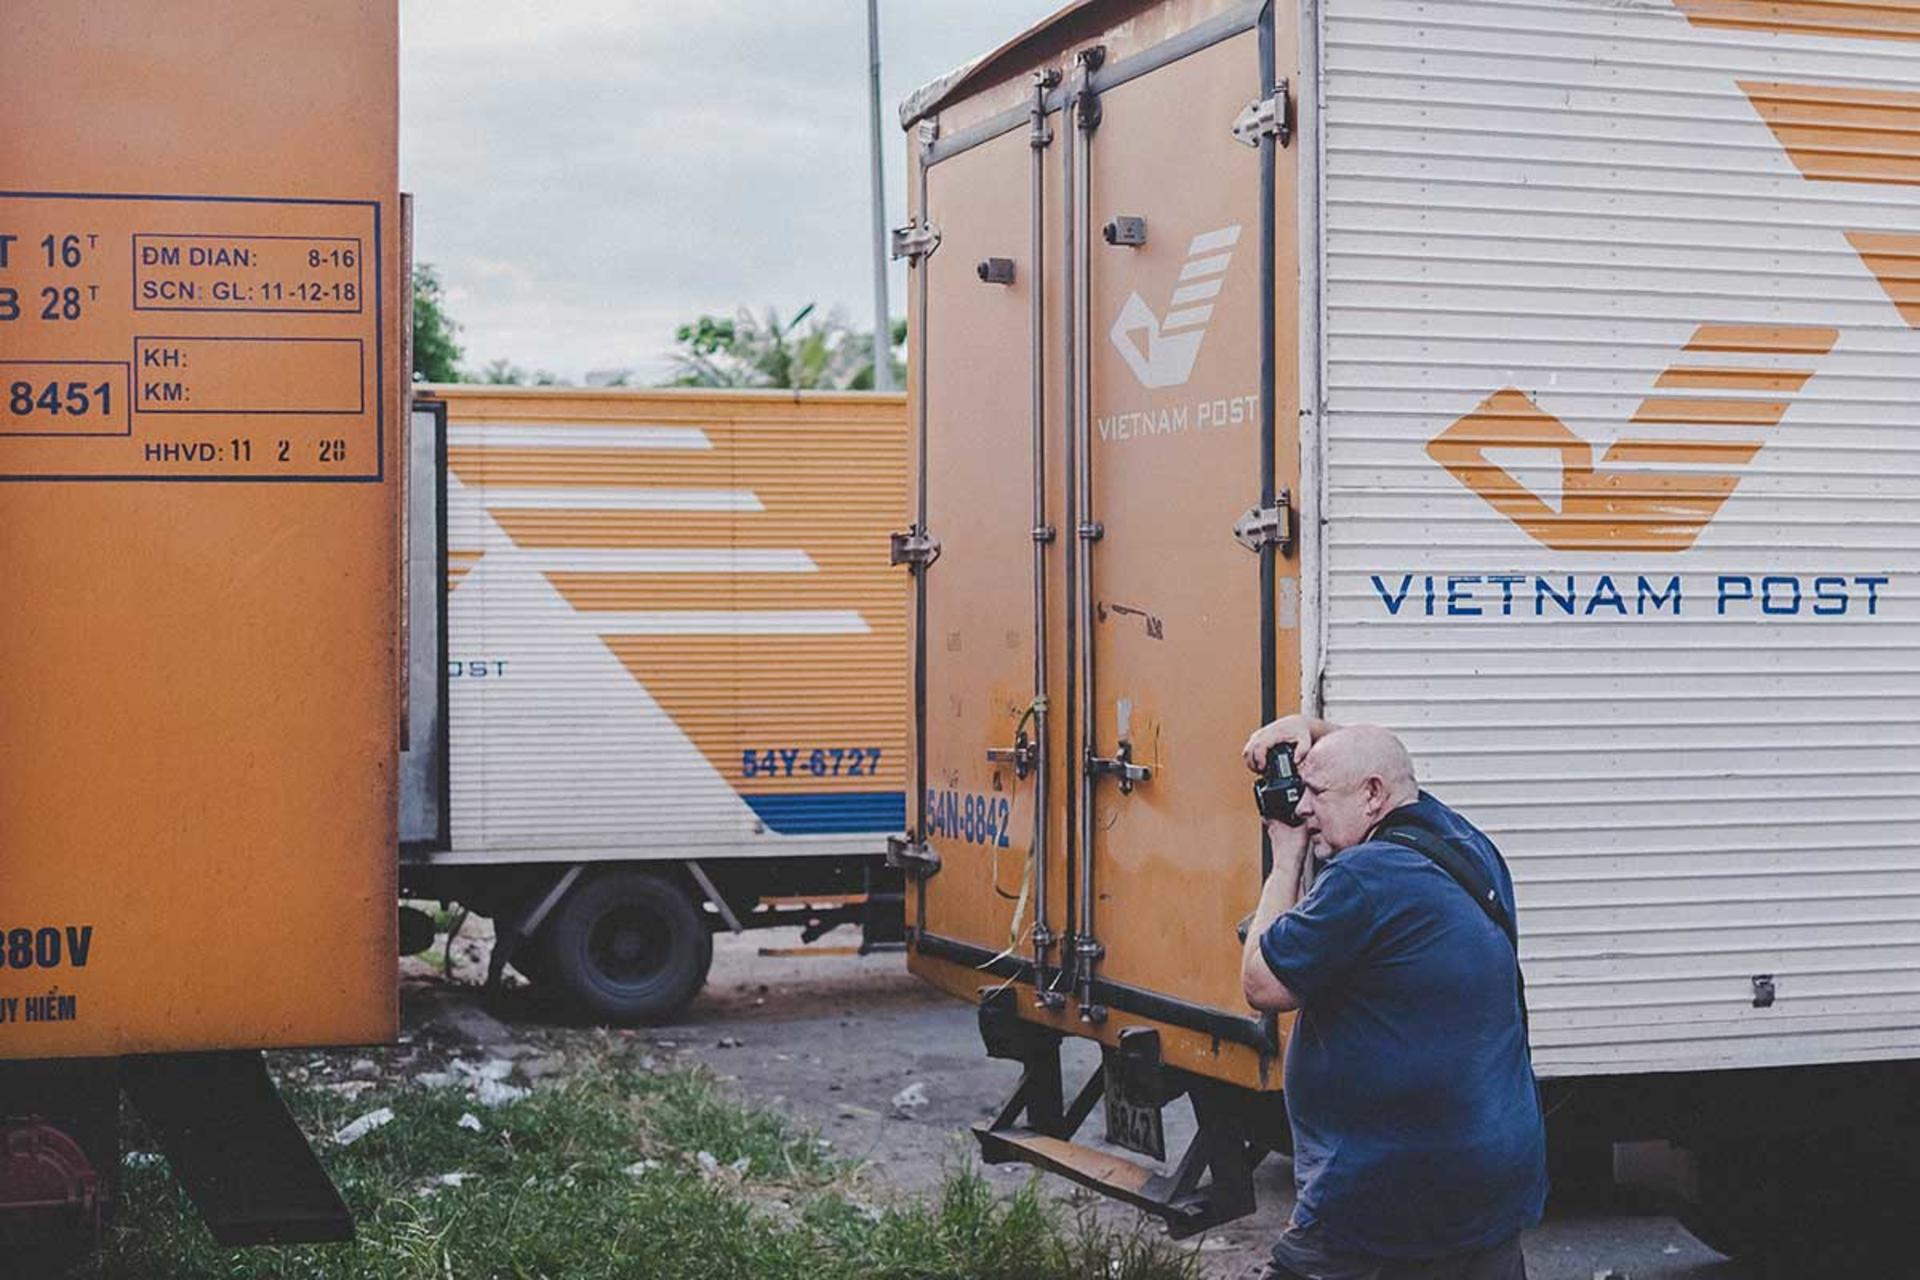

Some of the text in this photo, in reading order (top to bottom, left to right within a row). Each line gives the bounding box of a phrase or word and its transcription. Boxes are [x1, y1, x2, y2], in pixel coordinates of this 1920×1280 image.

[142, 246, 355, 268] ĐM DIAN: 8-16
[212, 281, 254, 301] GL:
[144, 348, 188, 367] KH:
[10, 382, 111, 416] 8451
[144, 382, 190, 401] KM:
[1098, 396, 1258, 441] VIETNAM POST
[145, 442, 224, 463] HHVD:
[1370, 575, 1890, 616] VIETNAM POST
[742, 747, 882, 778] 54Y-6727
[927, 788, 1010, 848] 54N-8842
[0, 925, 93, 970] 80V
